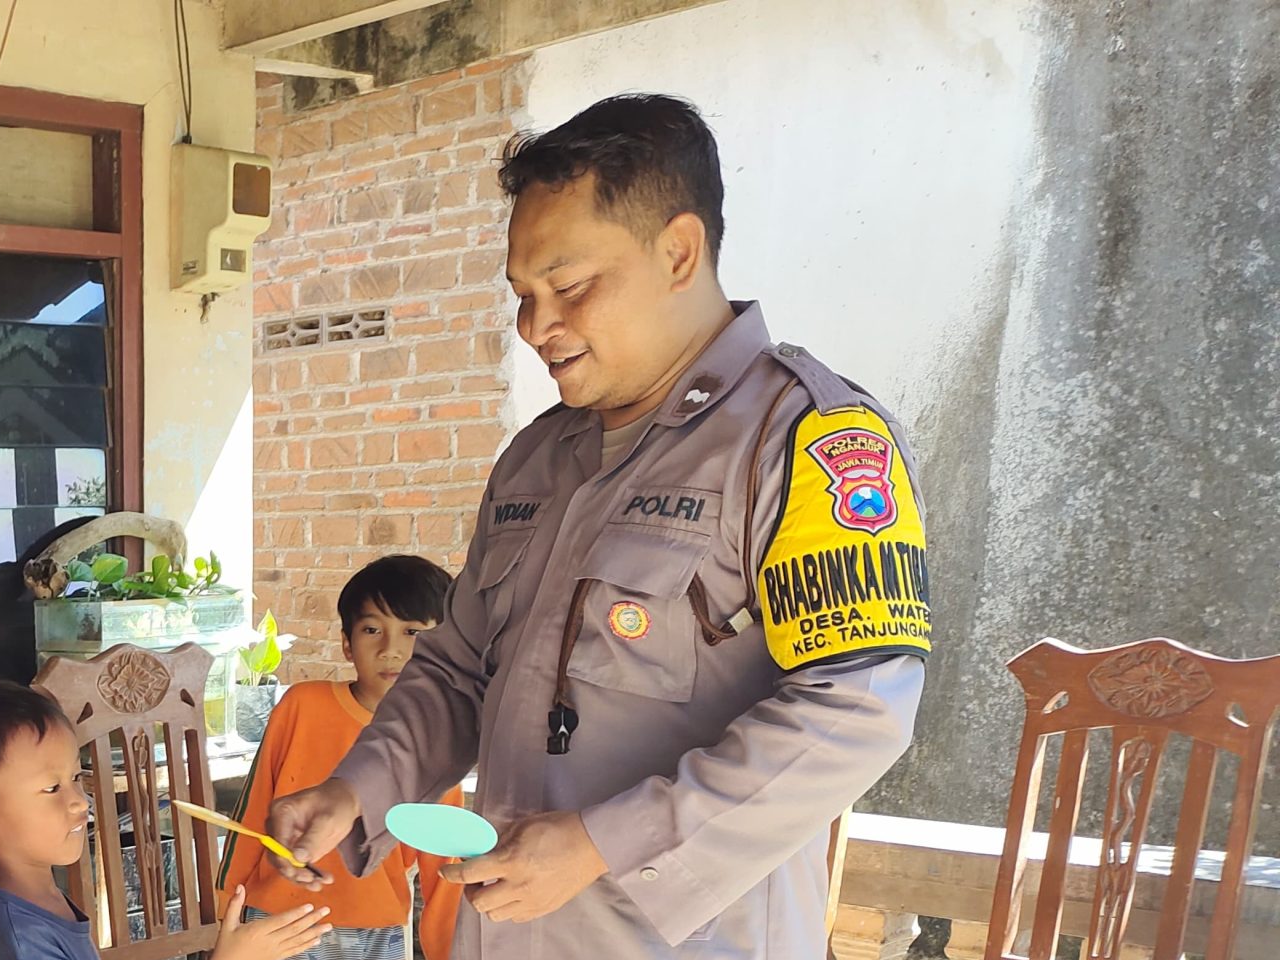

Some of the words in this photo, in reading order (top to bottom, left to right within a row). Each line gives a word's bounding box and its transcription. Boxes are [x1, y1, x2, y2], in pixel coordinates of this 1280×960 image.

[821, 435, 885, 455] POLRES
[830, 442, 882, 457] NGANJUK
[837, 460, 861, 472] JAWA
[862, 458, 884, 470] TIMUR
[623, 495, 706, 522] POLRI
